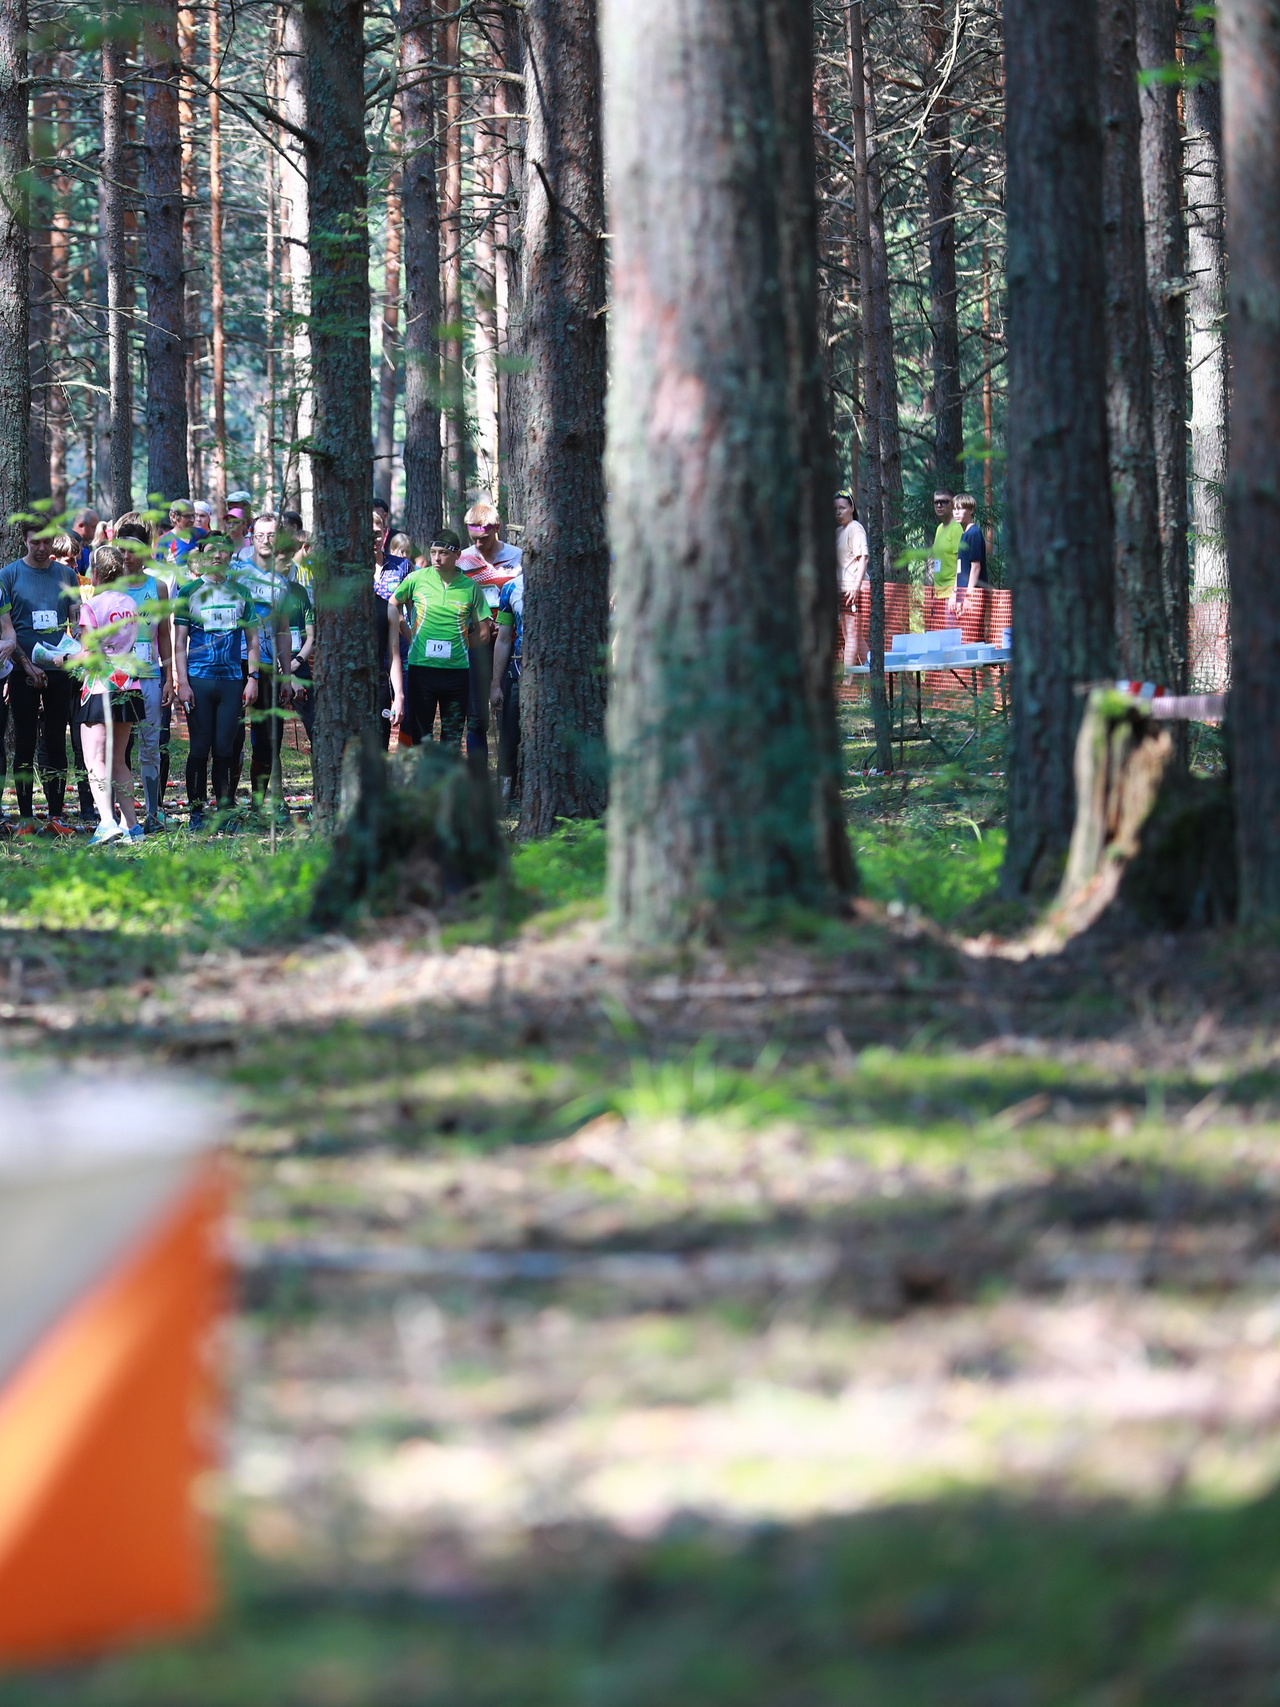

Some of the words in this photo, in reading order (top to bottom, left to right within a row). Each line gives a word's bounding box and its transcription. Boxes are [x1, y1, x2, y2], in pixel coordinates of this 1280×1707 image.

[255, 586, 264, 595] 16
[214, 613, 222, 621] 14
[432, 644, 443, 652] 19
